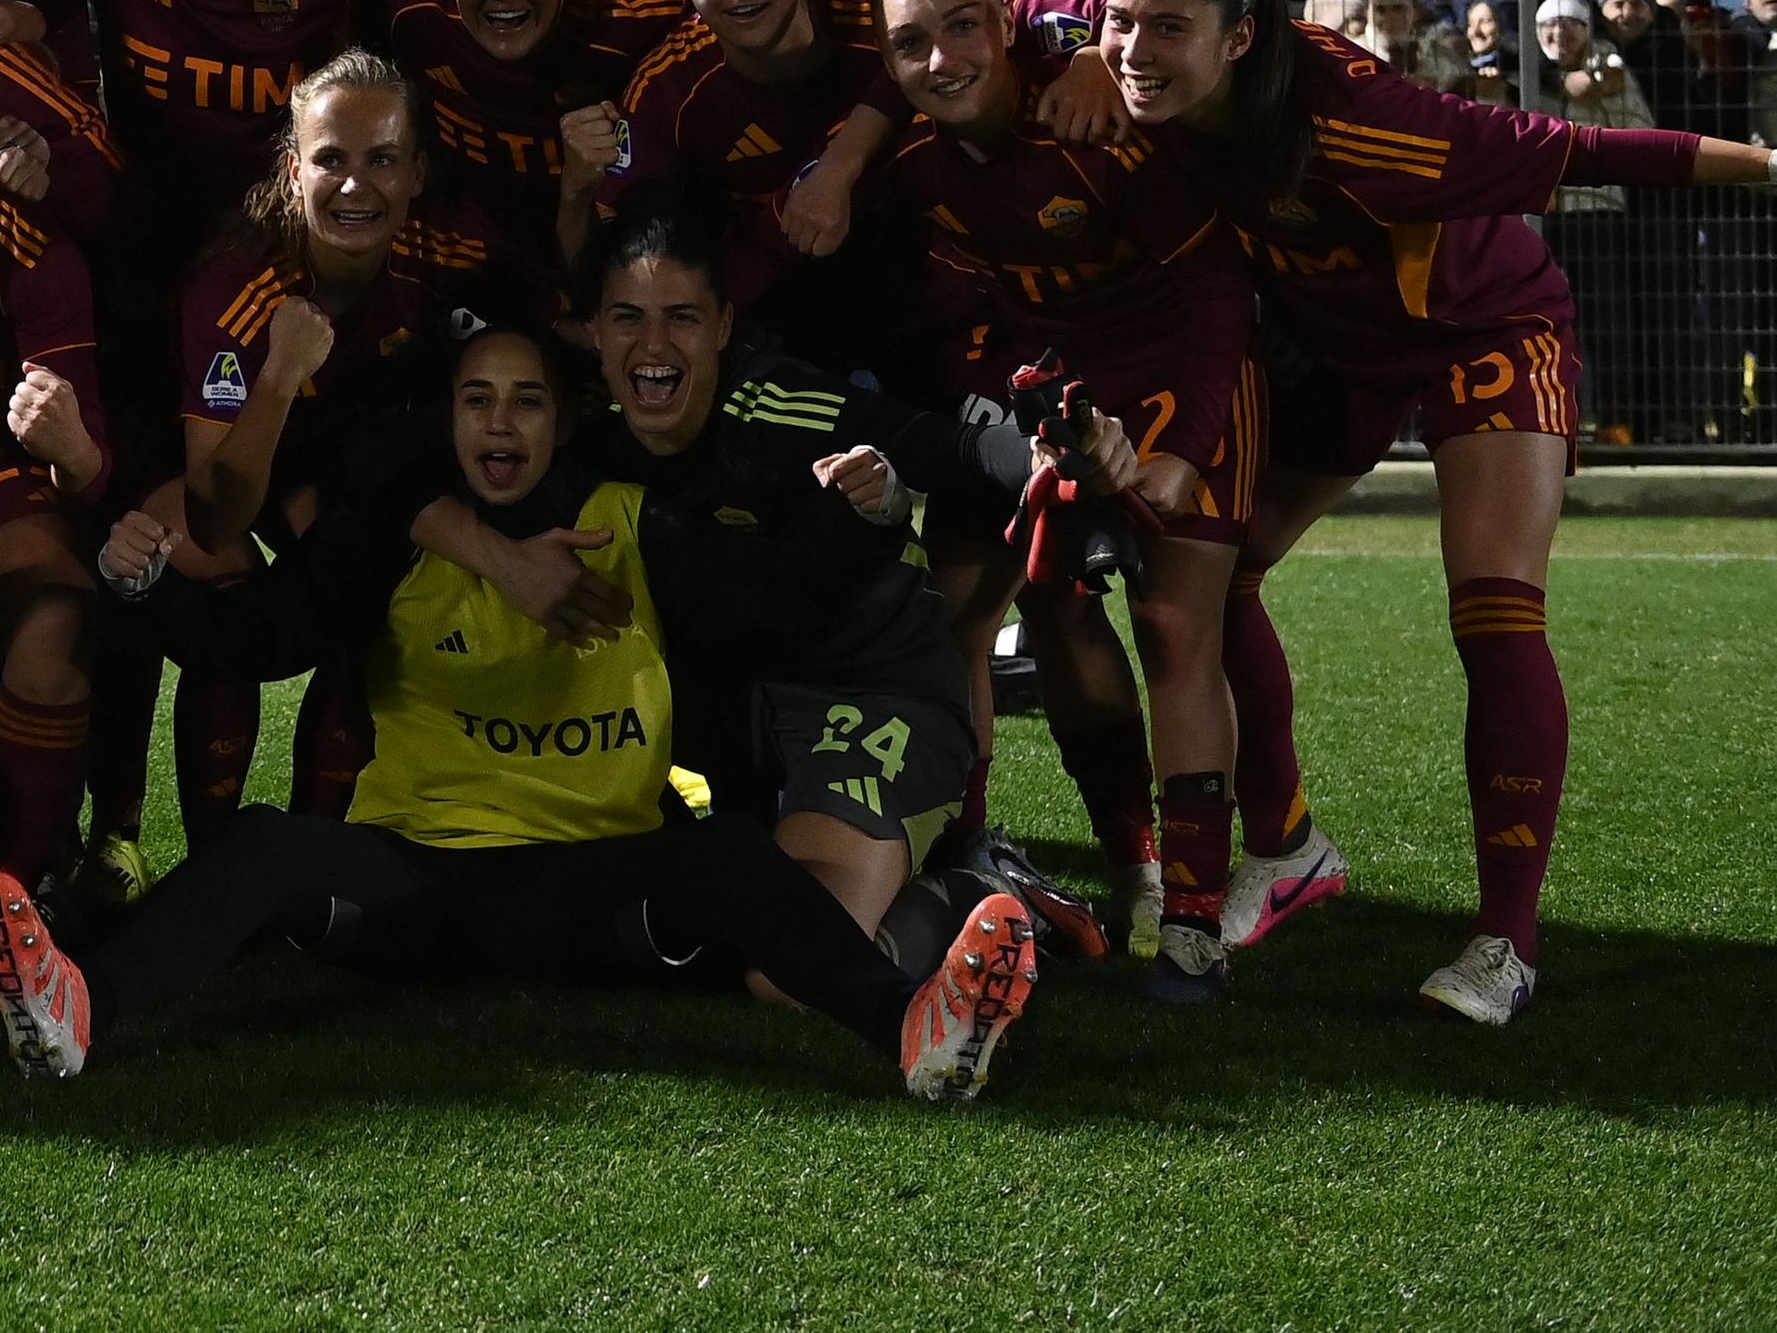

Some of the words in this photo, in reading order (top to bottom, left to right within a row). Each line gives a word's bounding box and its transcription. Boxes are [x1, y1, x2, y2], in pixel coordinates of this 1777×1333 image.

[184, 55, 302, 115] TIM
[453, 706, 647, 757] TOYOTA
[810, 703, 913, 786] 24
[1489, 773, 1543, 795] ASR
